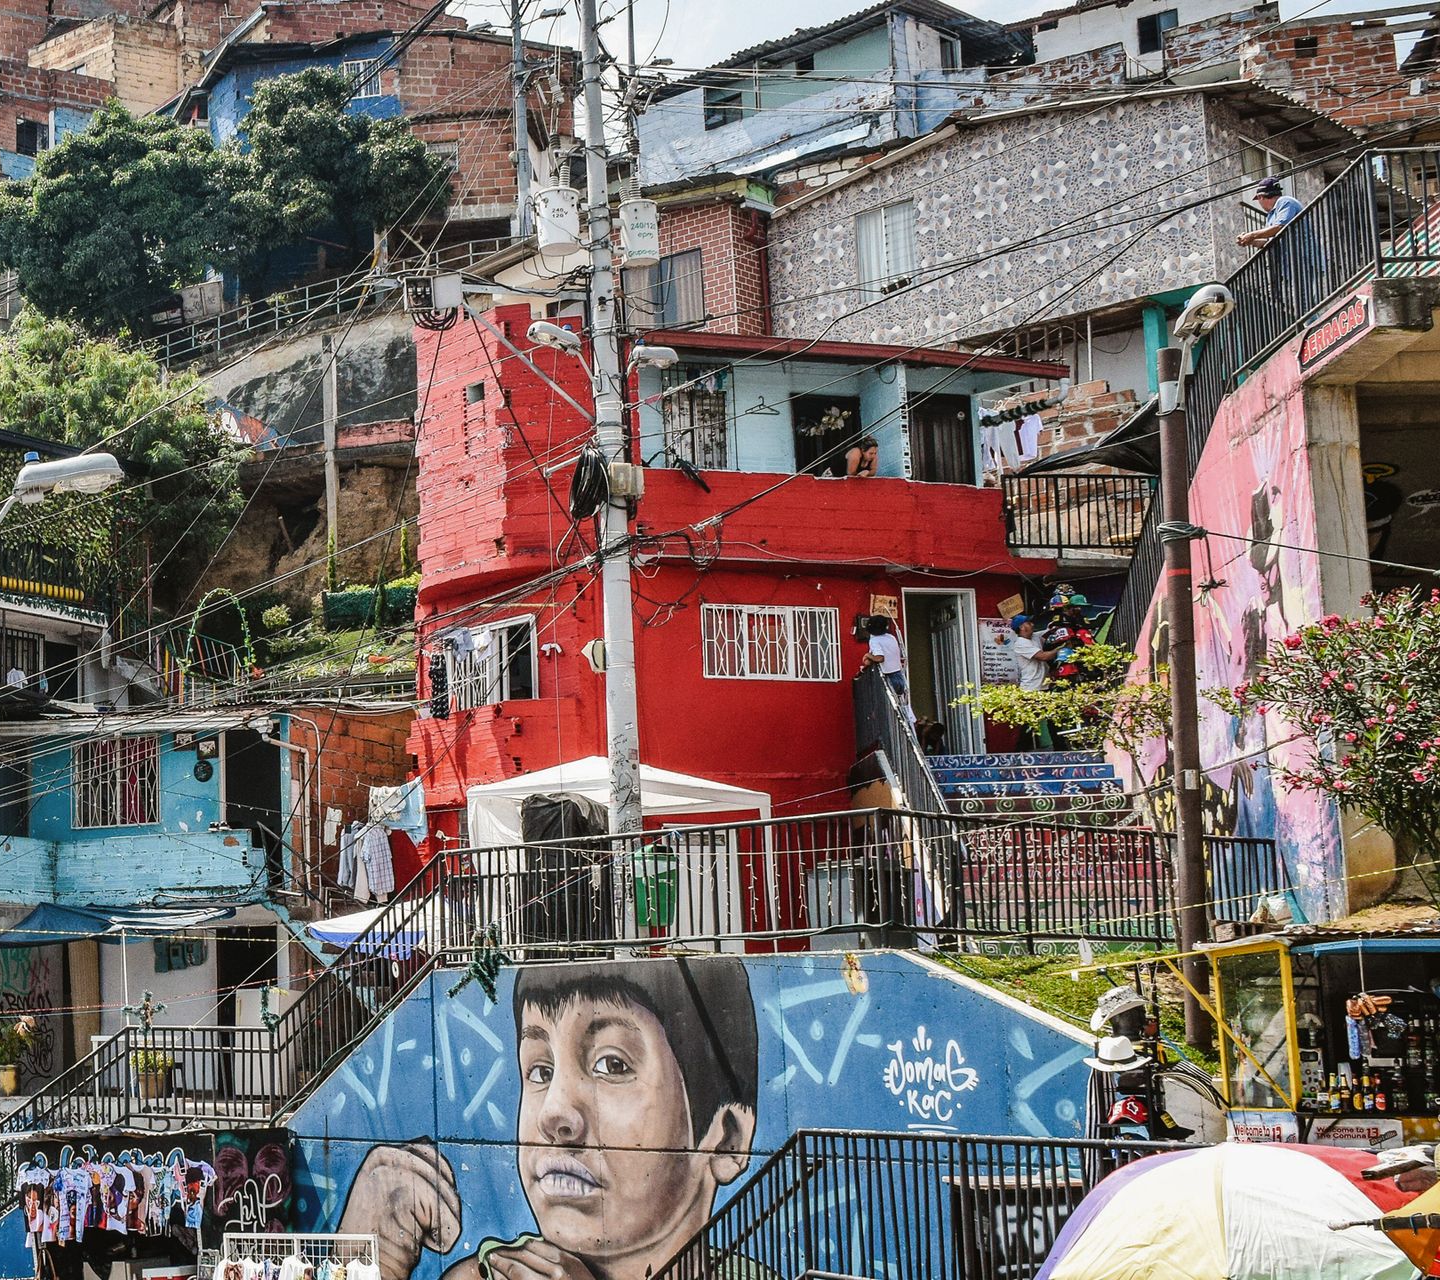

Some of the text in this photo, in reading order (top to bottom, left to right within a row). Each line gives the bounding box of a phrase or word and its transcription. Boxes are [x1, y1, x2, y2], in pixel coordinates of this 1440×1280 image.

[1301, 300, 1365, 366] BERRACAS
[1235, 1124, 1261, 1136] Welcome
[1262, 1124, 1271, 1137] to
[1366, 1127, 1380, 1140] 13
